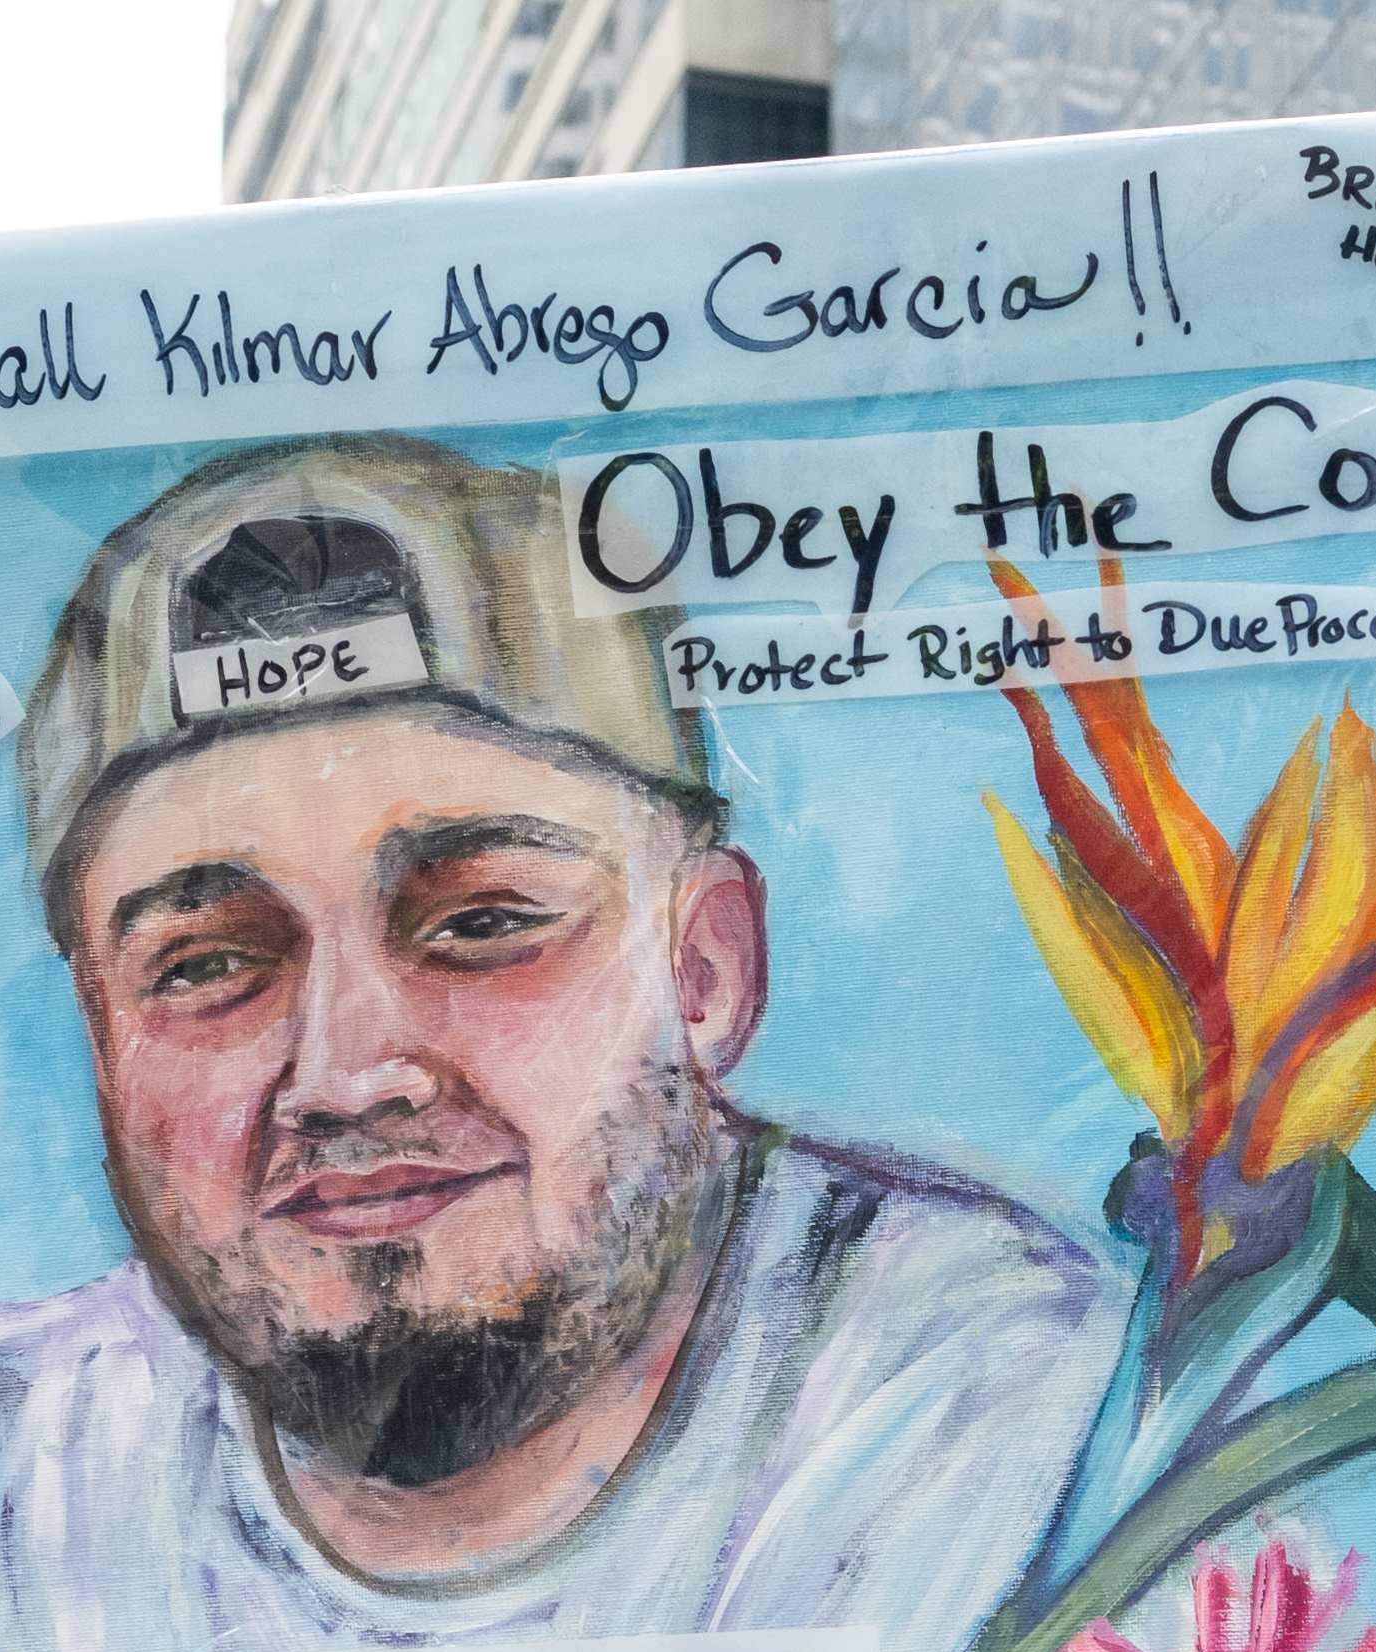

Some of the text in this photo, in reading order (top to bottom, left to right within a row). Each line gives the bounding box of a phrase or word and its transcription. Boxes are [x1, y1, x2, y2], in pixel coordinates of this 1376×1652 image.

[140, 289, 392, 398] Kilmar
[427, 264, 669, 411] Abrego
[705, 170, 1191, 352] Garcia!!
[578, 448, 895, 628] Obey
[955, 430, 1172, 558] the
[217, 640, 369, 707] HOPE
[671, 628, 888, 694] Protect
[919, 620, 1063, 695] Right
[1076, 608, 1132, 661] to
